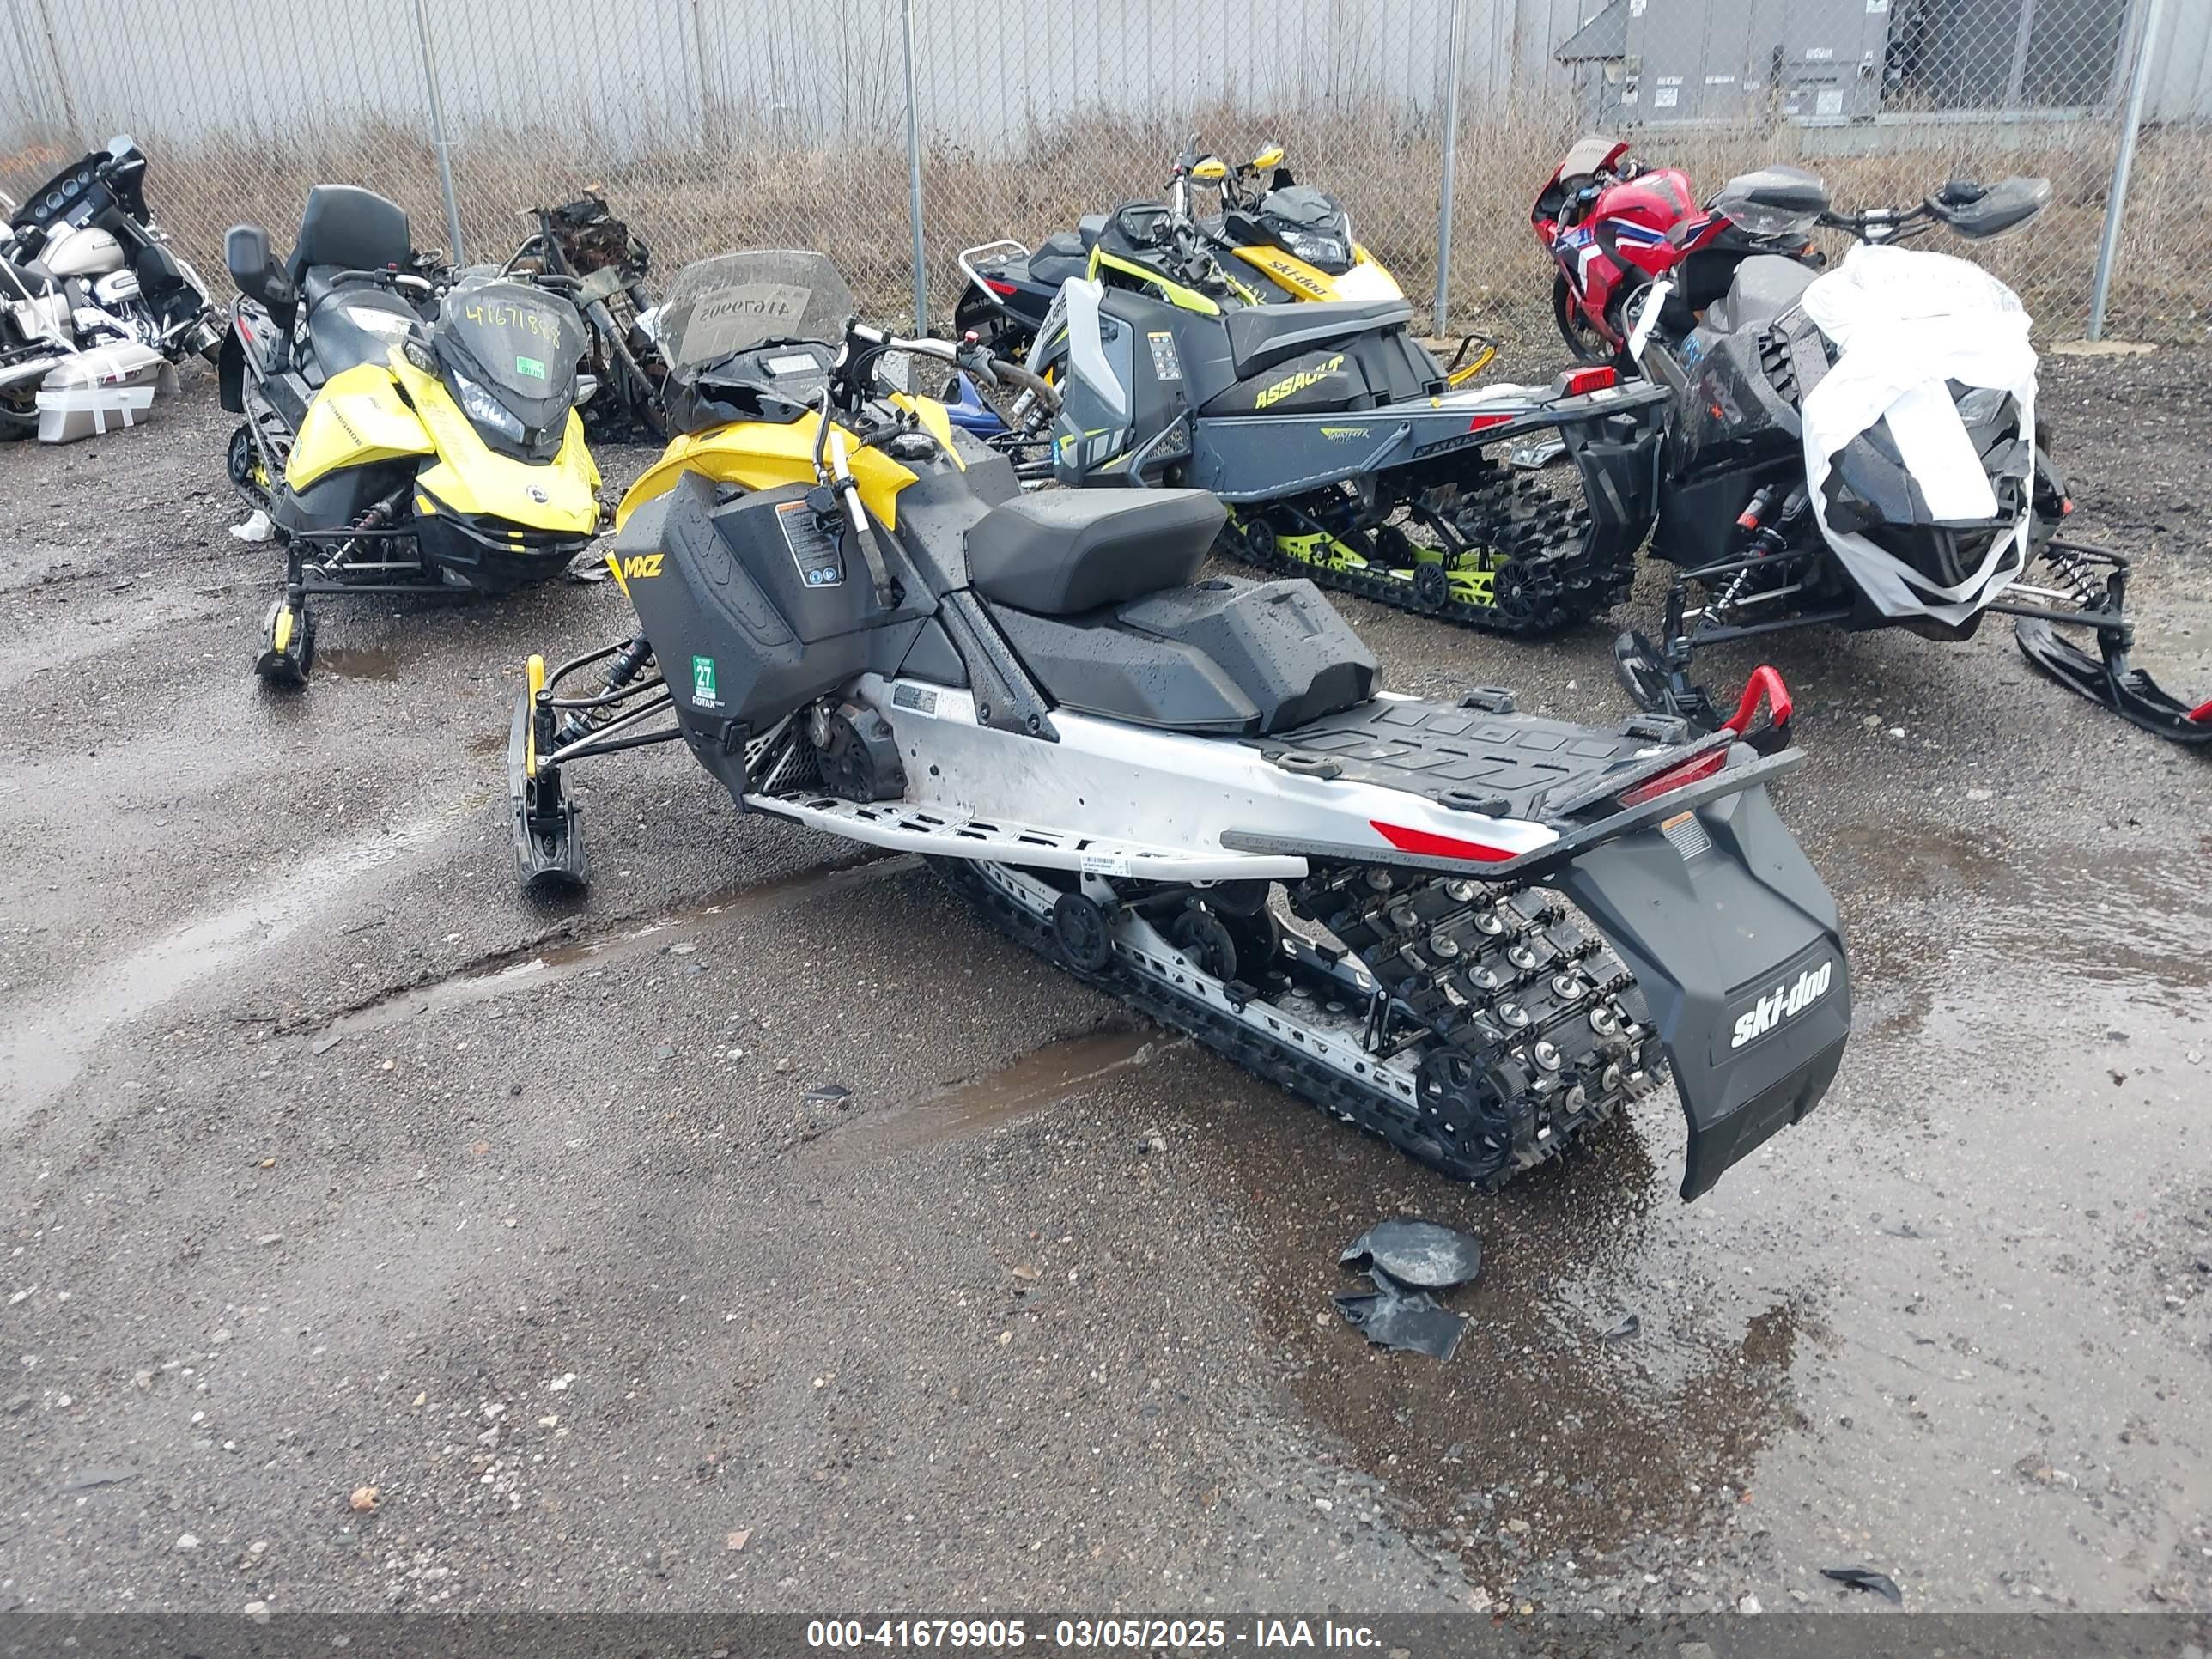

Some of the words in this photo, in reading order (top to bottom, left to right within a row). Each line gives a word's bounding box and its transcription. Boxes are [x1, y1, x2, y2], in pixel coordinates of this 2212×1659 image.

[1267, 260, 1328, 296] ski-doo
[466, 304, 561, 349] 41671888
[1255, 355, 1345, 410] ASSAULT
[624, 554, 665, 579] MXZ
[696, 665, 712, 687] 27
[692, 696, 715, 709] ROTAX
[1731, 962, 1832, 1049] ski-doo
